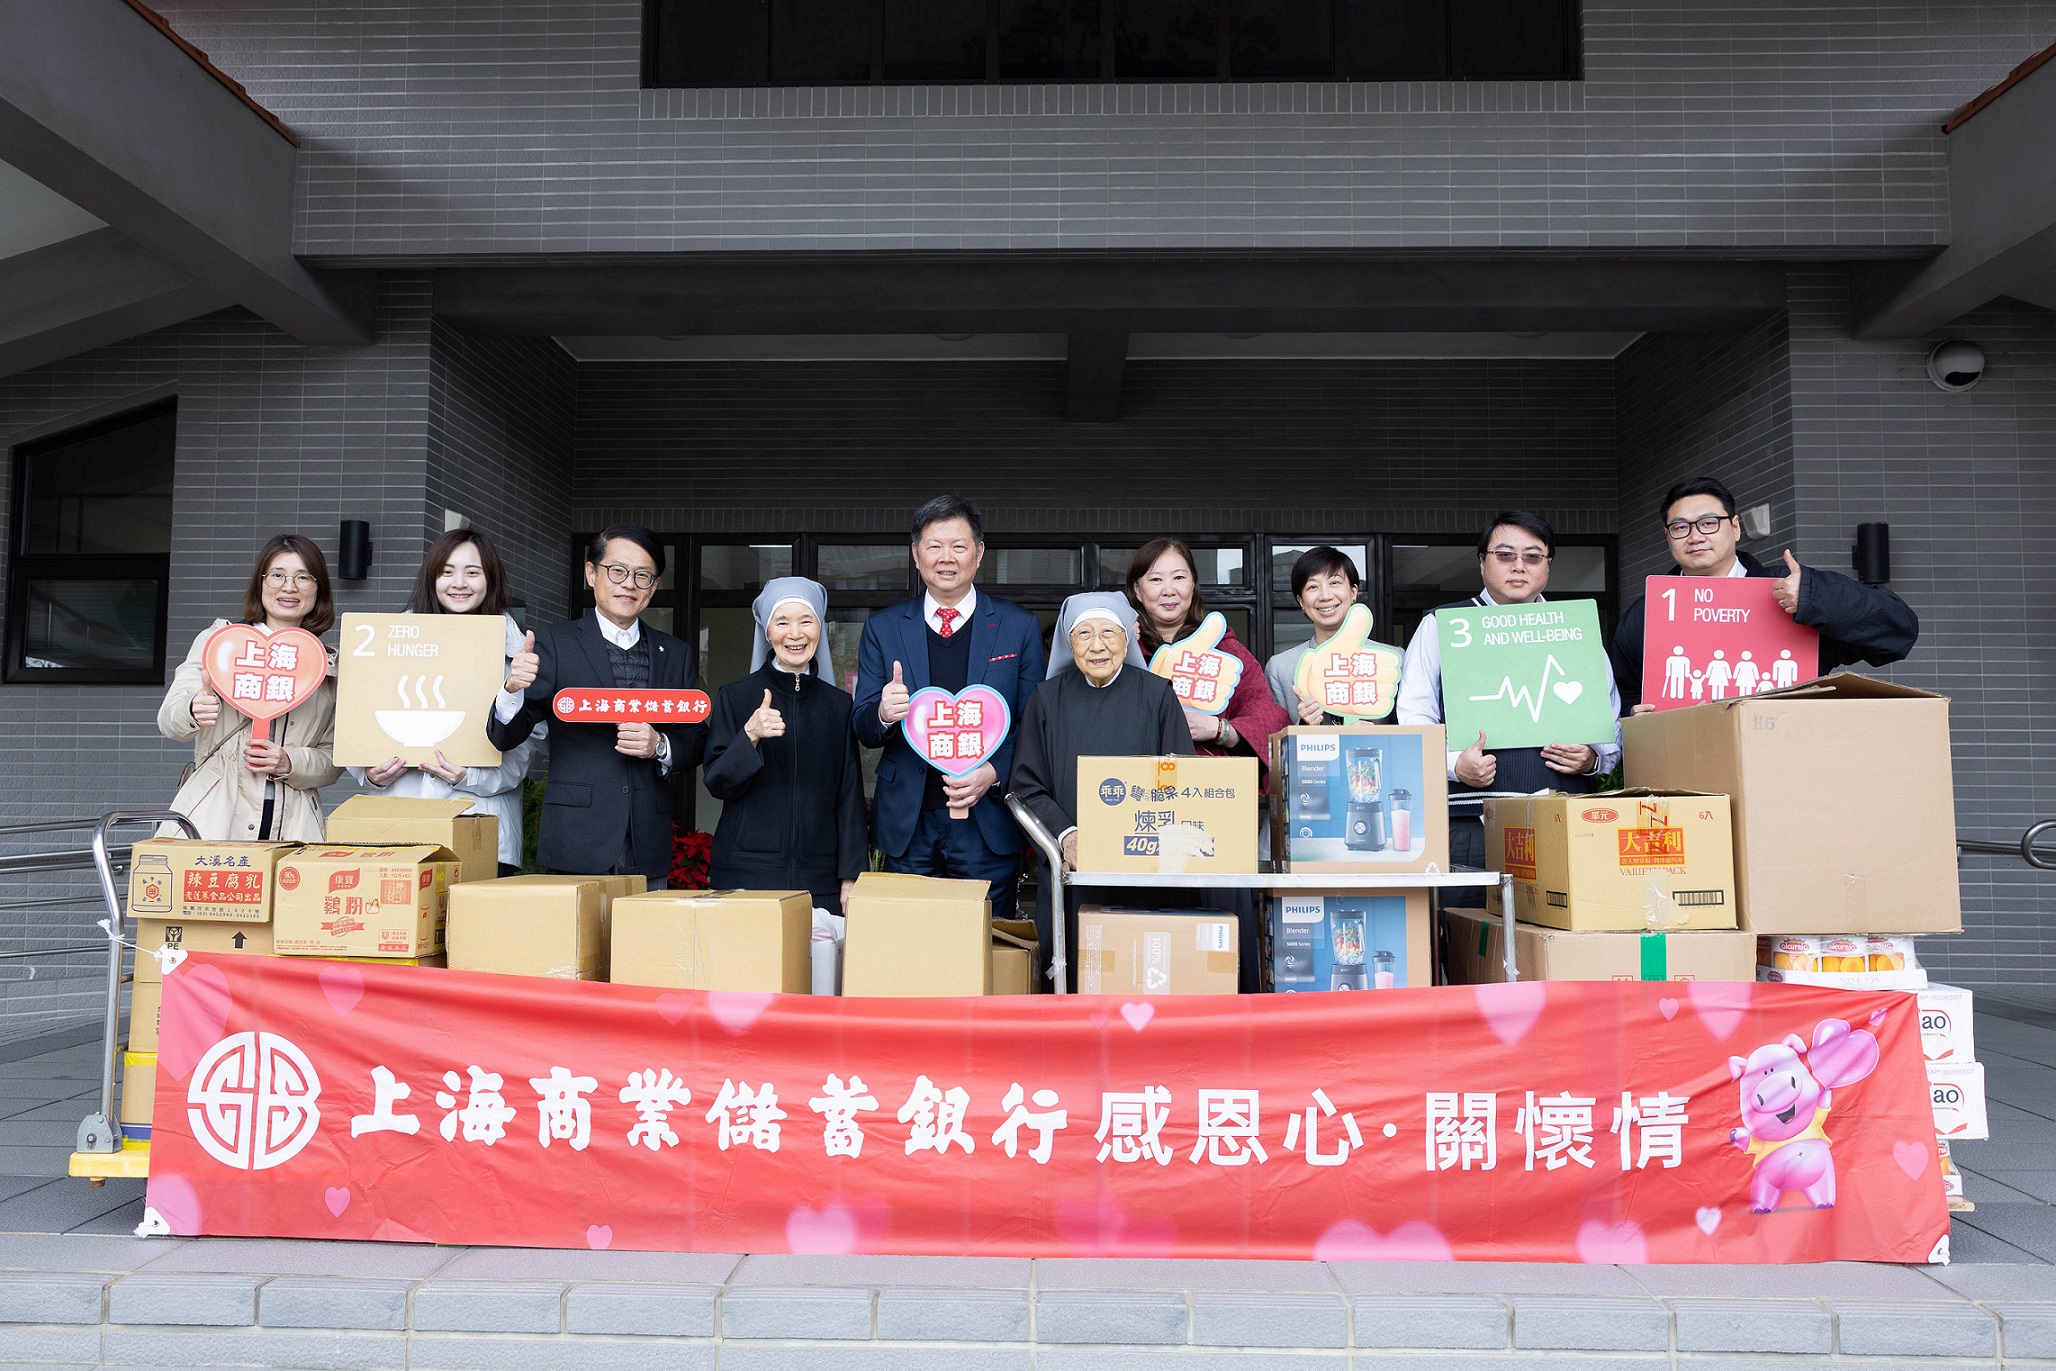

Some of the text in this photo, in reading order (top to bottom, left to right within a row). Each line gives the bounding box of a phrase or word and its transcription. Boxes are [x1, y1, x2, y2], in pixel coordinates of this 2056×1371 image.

[1694, 588, 1714, 603] NO
[1661, 588, 1676, 622] 1
[1481, 611, 1564, 629] GOOD HEALTH
[1693, 608, 1751, 623] POVERTY
[352, 624, 376, 657] 2
[387, 625, 420, 639] ZERO
[1448, 618, 1473, 648] 3
[1483, 627, 1583, 646] AND WELL-BEING
[235, 640, 298, 671] 上海
[387, 643, 439, 657] HUNGER
[1173, 651, 1223, 678] 上海
[1324, 653, 1377, 678] 上海
[233, 672, 296, 702] 商銀
[1171, 676, 1217, 703] 商銀
[1326, 680, 1379, 706] 商銀
[578, 698, 708, 714] 上海商業儲蓄銀行
[927, 700, 983, 728] 上海
[927, 731, 984, 760] 商銀
[1300, 744, 1336, 752] PHILIPS
[1698, 810, 1714, 820] 6入
[1126, 837, 1159, 855] 40g
[1506, 831, 1534, 862] 大吉利
[1621, 831, 1682, 853] 大吉利
[194, 855, 252, 868] 大溪名產
[1620, 867, 1660, 876] VARIE
[186, 872, 261, 890] 辣豆腐乳
[1285, 906, 1321, 914] PHILIPS
[1151, 936, 1161, 965] 100%
[1922, 1015, 1947, 1029] ao
[1933, 1089, 1959, 1103] ao
